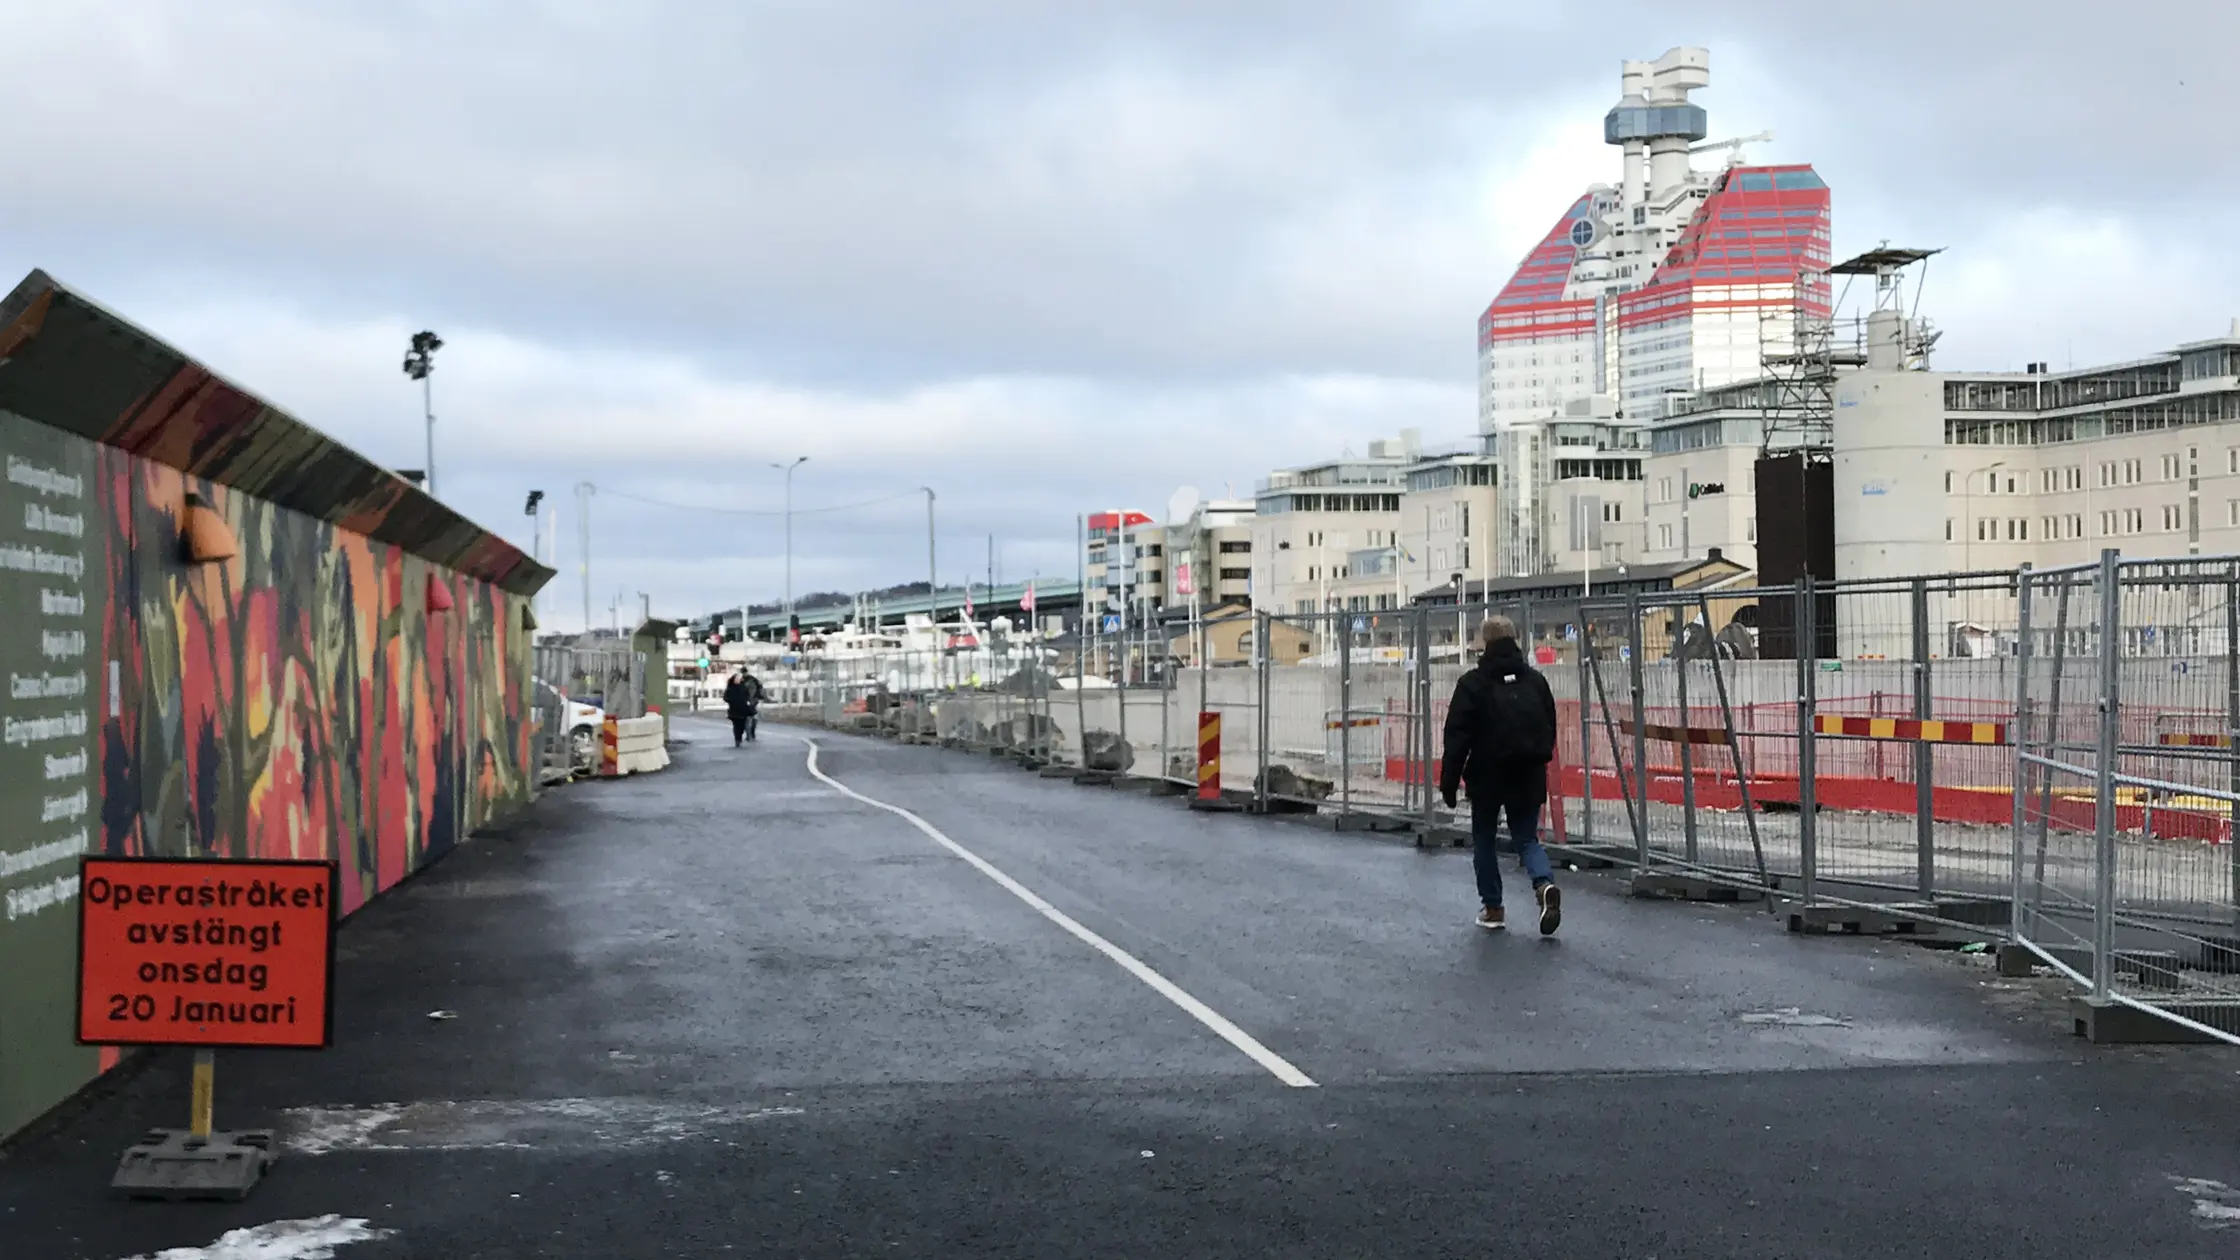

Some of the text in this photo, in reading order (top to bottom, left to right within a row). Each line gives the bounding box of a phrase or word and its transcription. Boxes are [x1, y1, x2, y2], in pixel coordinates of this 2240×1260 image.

[87, 877, 324, 910] Operastråket
[128, 918, 281, 952] avstängt
[138, 958, 267, 991] onsdag
[108, 994, 295, 1023] 20 Januari
